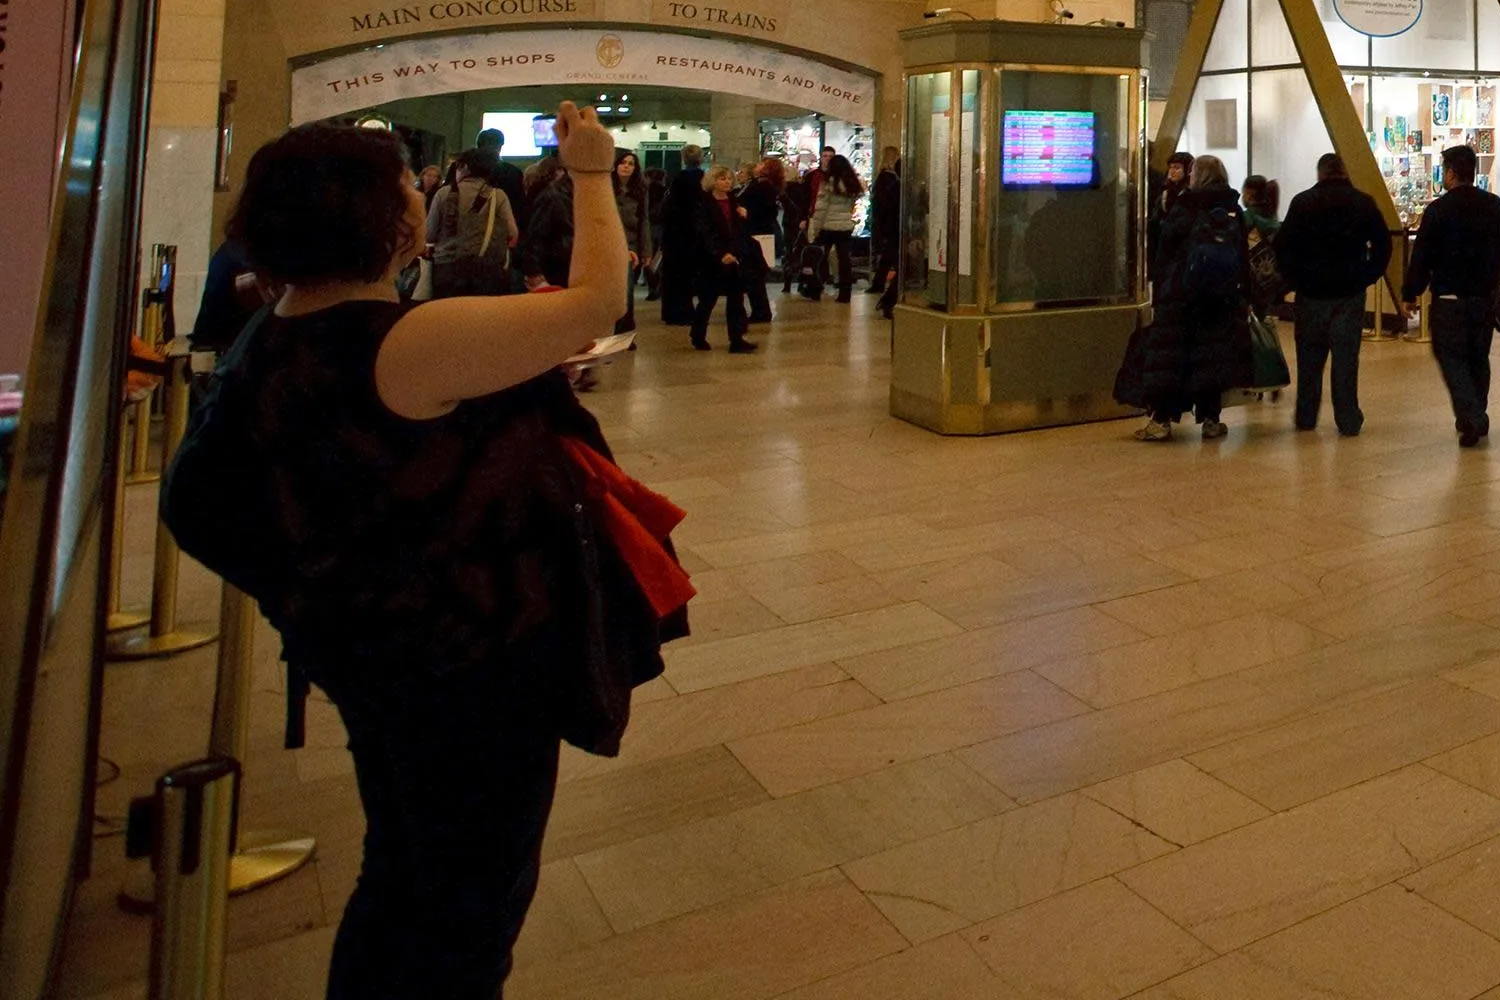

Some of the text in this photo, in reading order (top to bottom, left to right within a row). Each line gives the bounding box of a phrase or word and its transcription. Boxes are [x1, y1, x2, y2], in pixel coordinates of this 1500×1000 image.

[350, 6, 421, 32] MAIN
[669, 2, 777, 32] TO TRAINS
[327, 53, 556, 94] THIS WAY TO SHOPS
[656, 55, 863, 105] RESTAURANTS AND MORE
